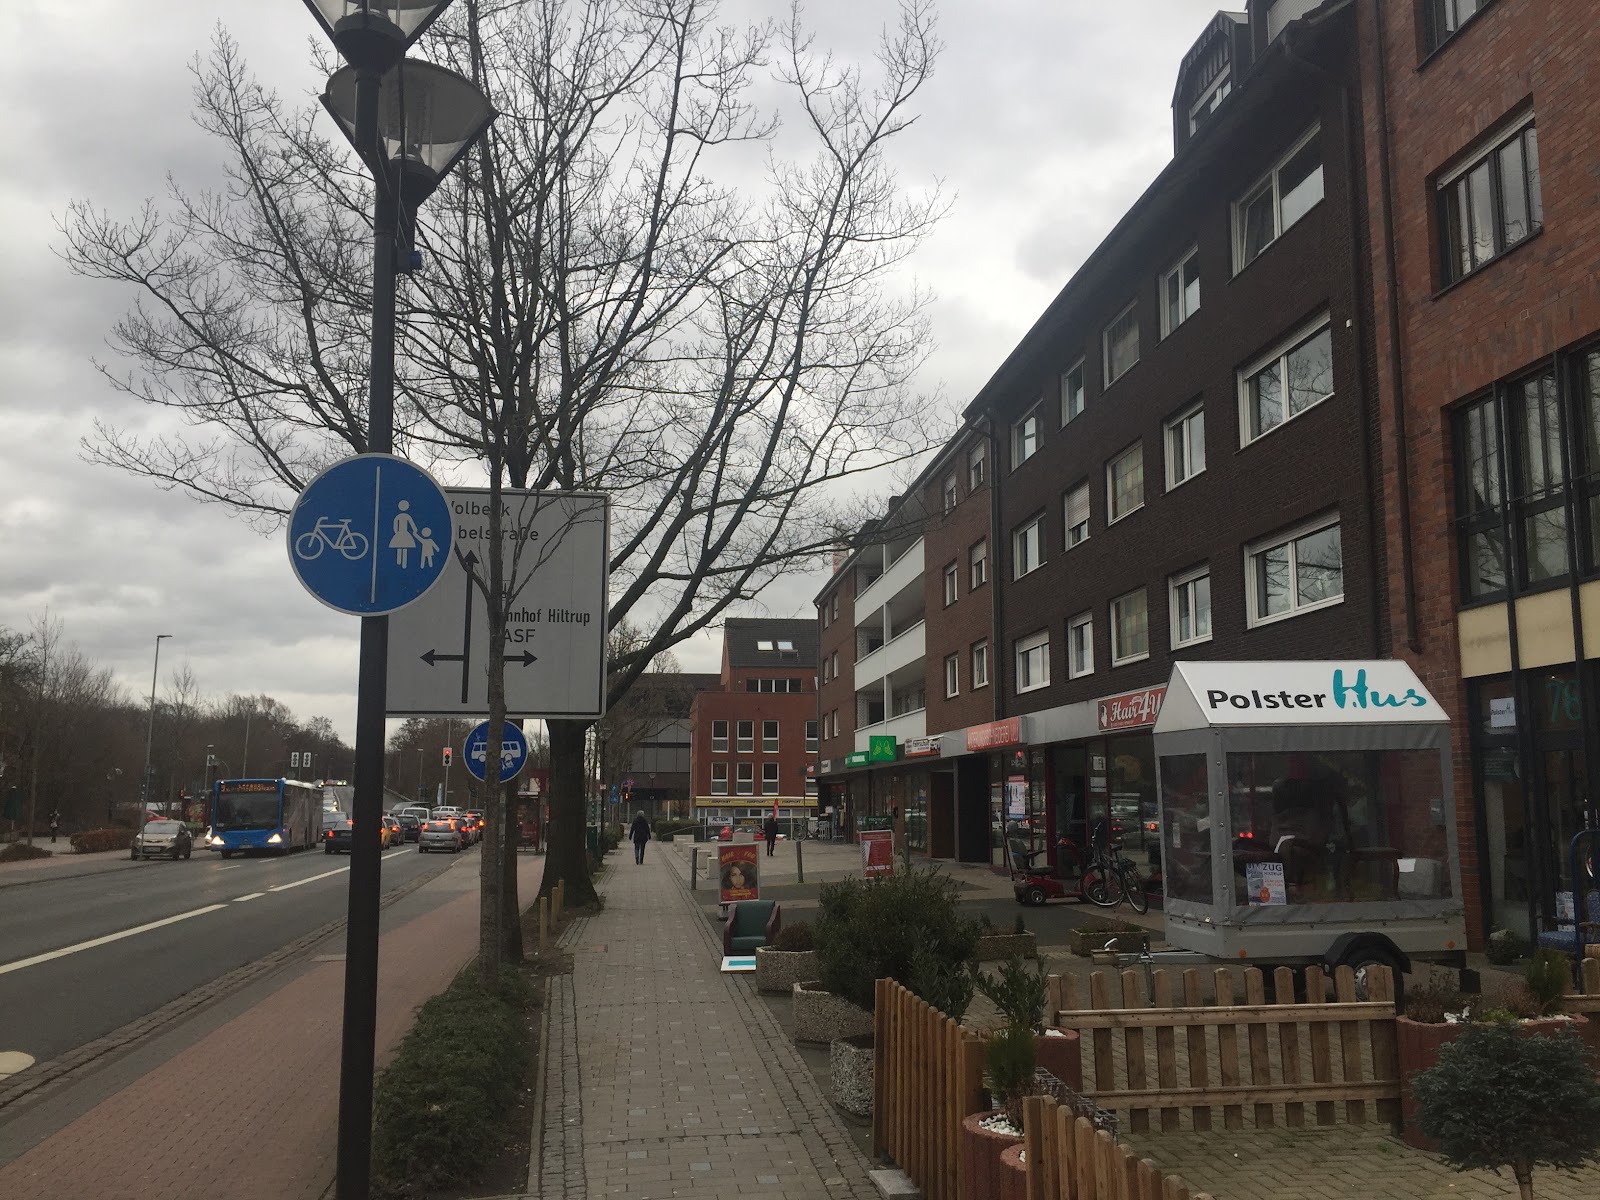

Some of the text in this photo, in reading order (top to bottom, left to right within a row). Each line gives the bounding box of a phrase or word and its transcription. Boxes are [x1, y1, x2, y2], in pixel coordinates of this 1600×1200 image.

[451, 501, 511, 516] olbek
[458, 525, 539, 541] belsraße
[506, 607, 590, 627] hnhof Hiltrup
[505, 628, 536, 643] ASF
[1207, 668, 1427, 709] Polster Hus
